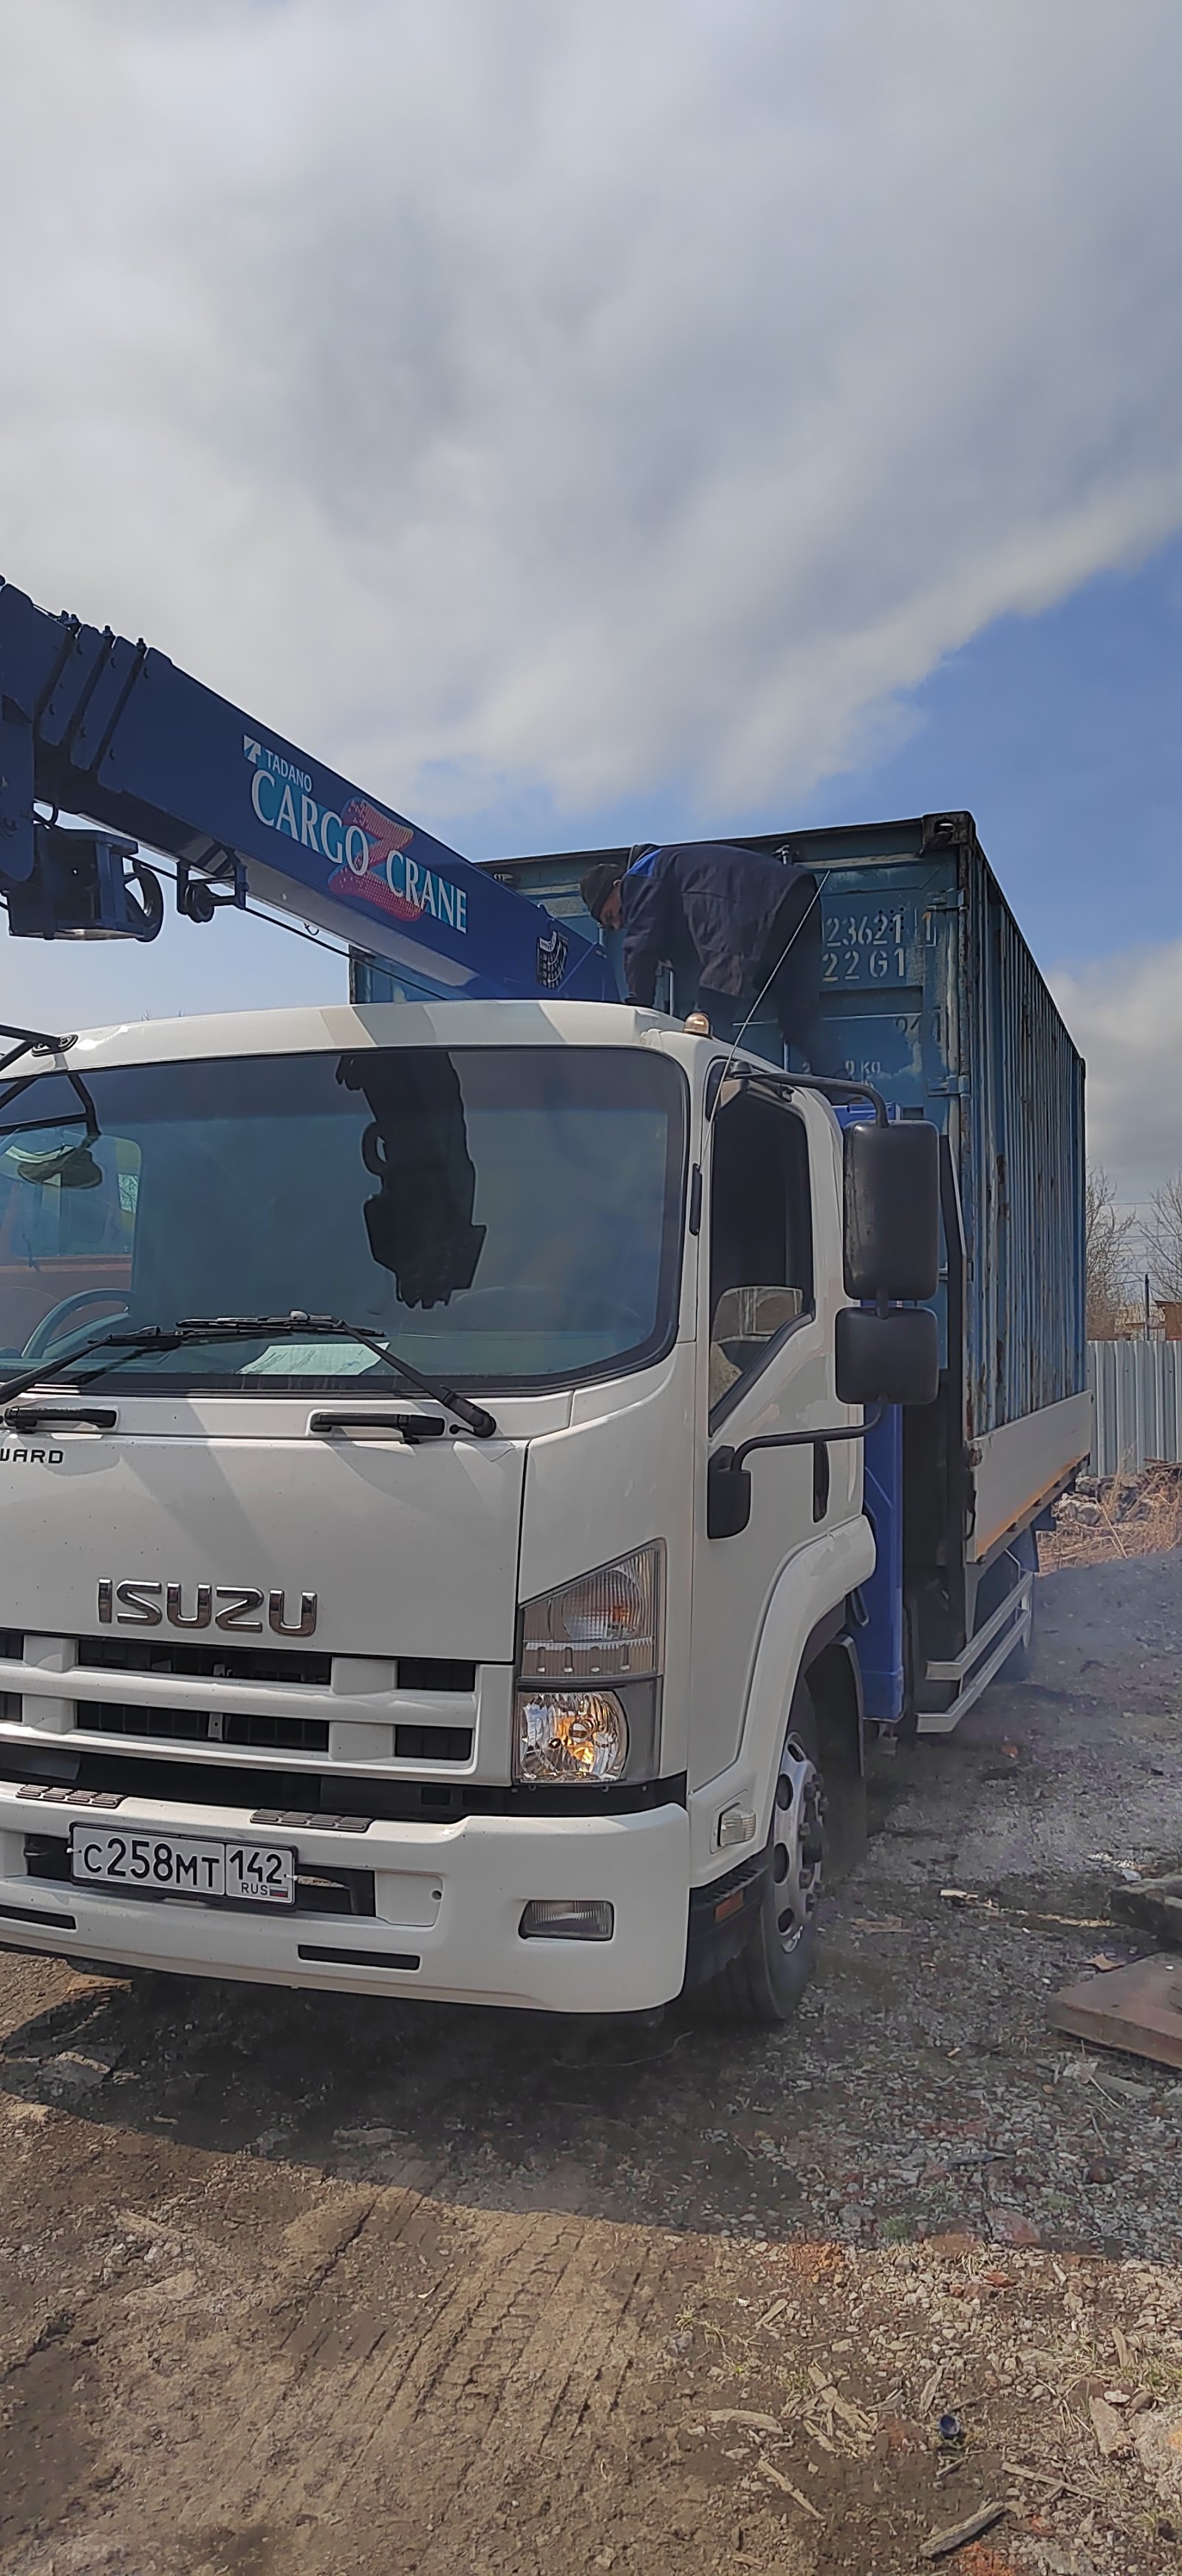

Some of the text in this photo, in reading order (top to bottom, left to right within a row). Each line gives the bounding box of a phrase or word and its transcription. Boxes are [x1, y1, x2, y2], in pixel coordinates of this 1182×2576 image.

[265, 749, 312, 793] TADANO
[251, 769, 369, 876] CARGO
[386, 850, 467, 934] CRANE
[98, 1578, 318, 1637] ISUZU
[229, 1850, 283, 1884] 142
[241, 1882, 268, 1895] RUS
